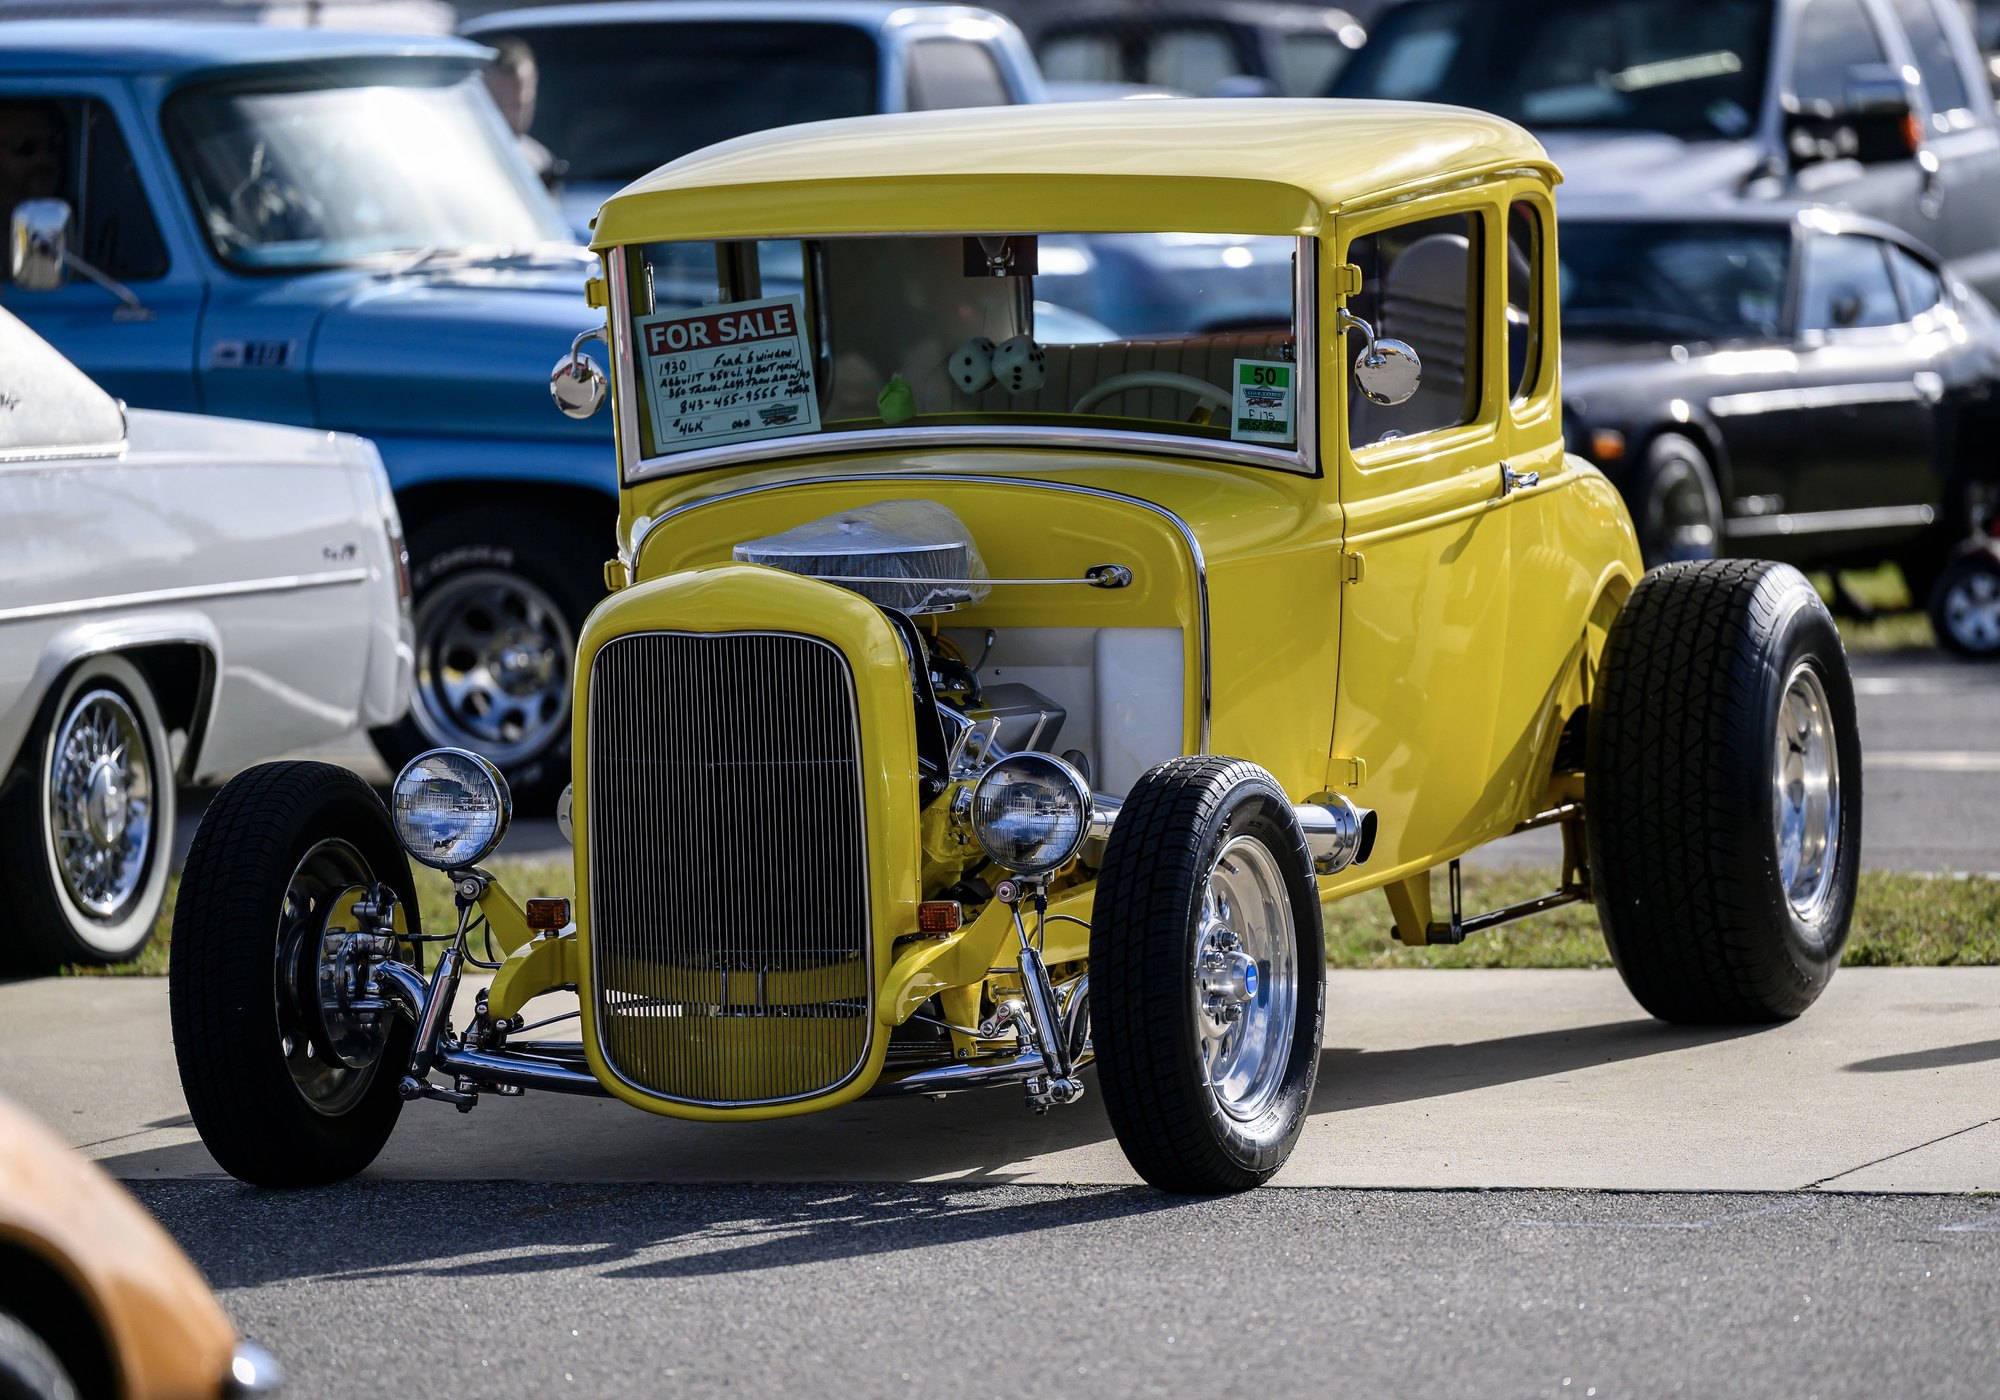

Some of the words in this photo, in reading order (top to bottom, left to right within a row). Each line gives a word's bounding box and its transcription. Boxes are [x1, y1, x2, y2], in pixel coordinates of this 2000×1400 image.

[650, 321, 712, 352] FOR
[717, 309, 792, 342] SALE
[659, 360, 687, 376] 1930
[1253, 367, 1277, 385] 50
[680, 385, 779, 414] 843-455-9555
[1260, 411, 1275, 421] 175
